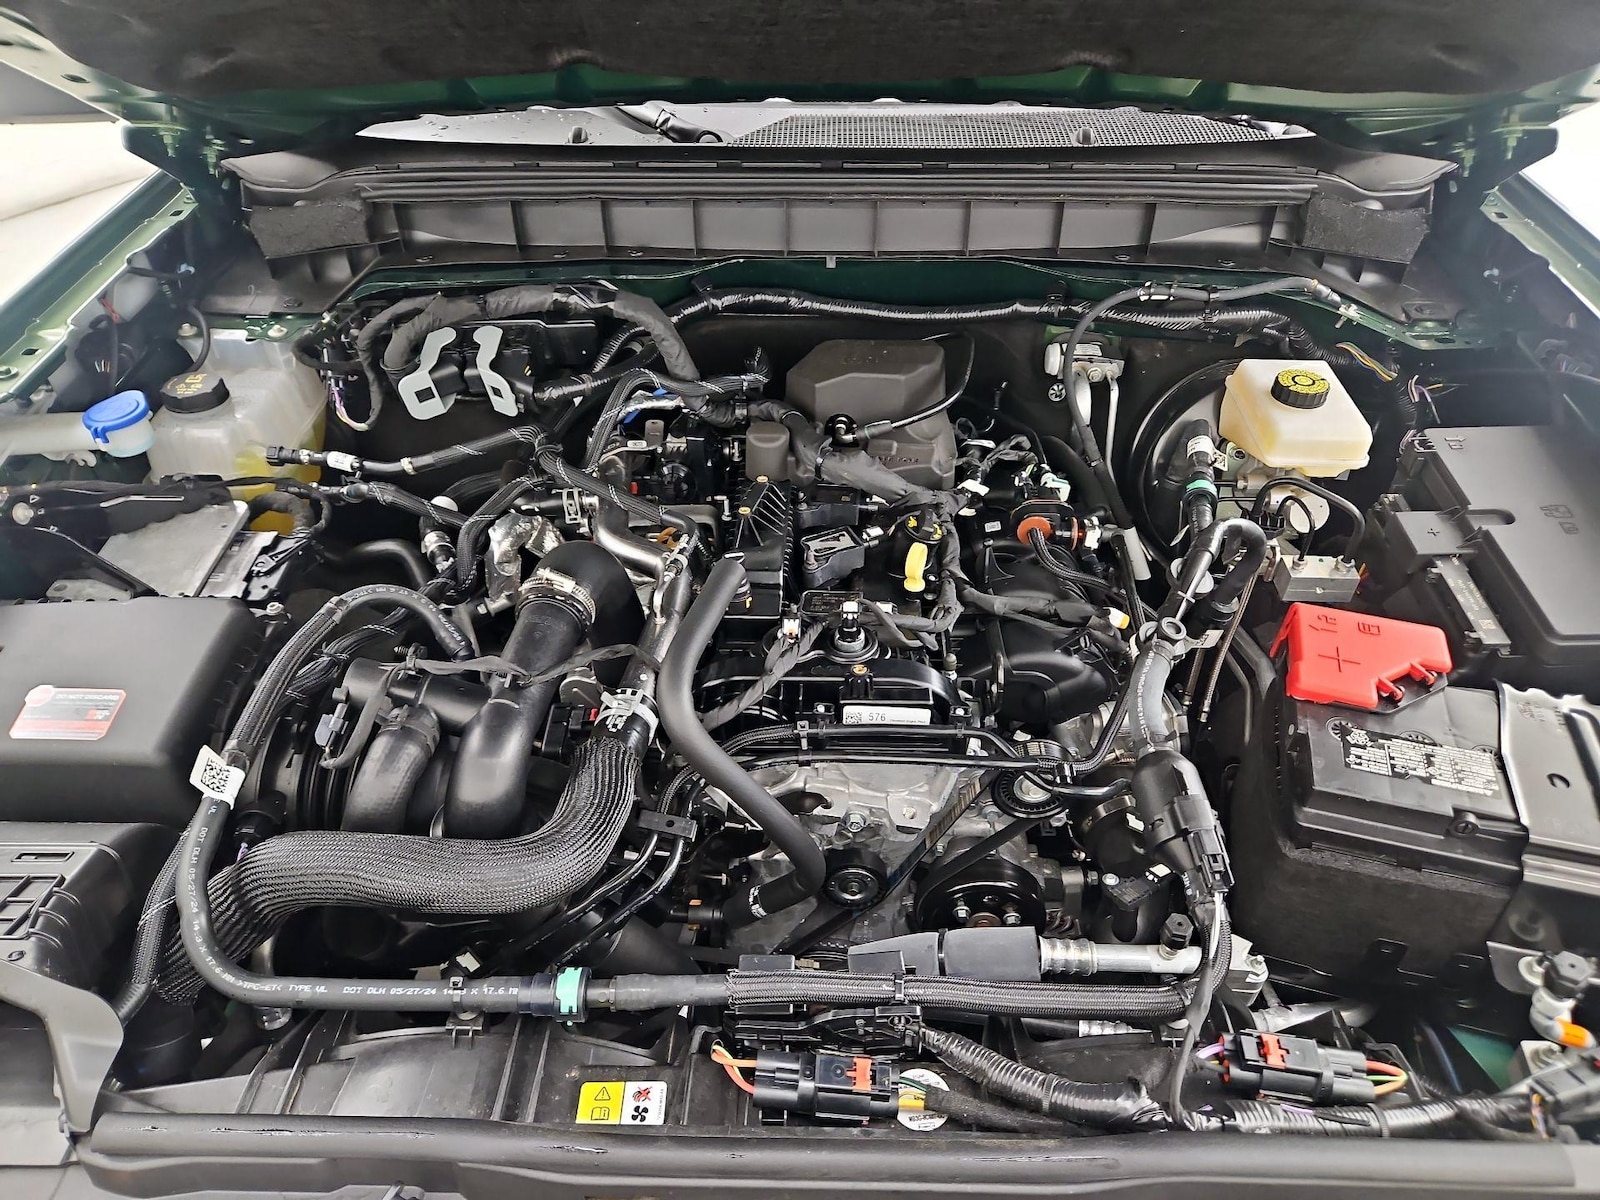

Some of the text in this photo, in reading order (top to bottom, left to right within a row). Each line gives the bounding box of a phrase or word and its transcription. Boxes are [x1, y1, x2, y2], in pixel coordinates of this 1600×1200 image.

[868, 712, 887, 722] 576
[197, 827, 209, 843] DOT
[191, 847, 201, 864] DLH
[187, 867, 200, 913] 05/27/24
[288, 984, 312, 992] TYPE
[342, 986, 364, 994] DOT
[366, 987, 387, 995] DLH
[389, 987, 438, 996] 05/27/24
